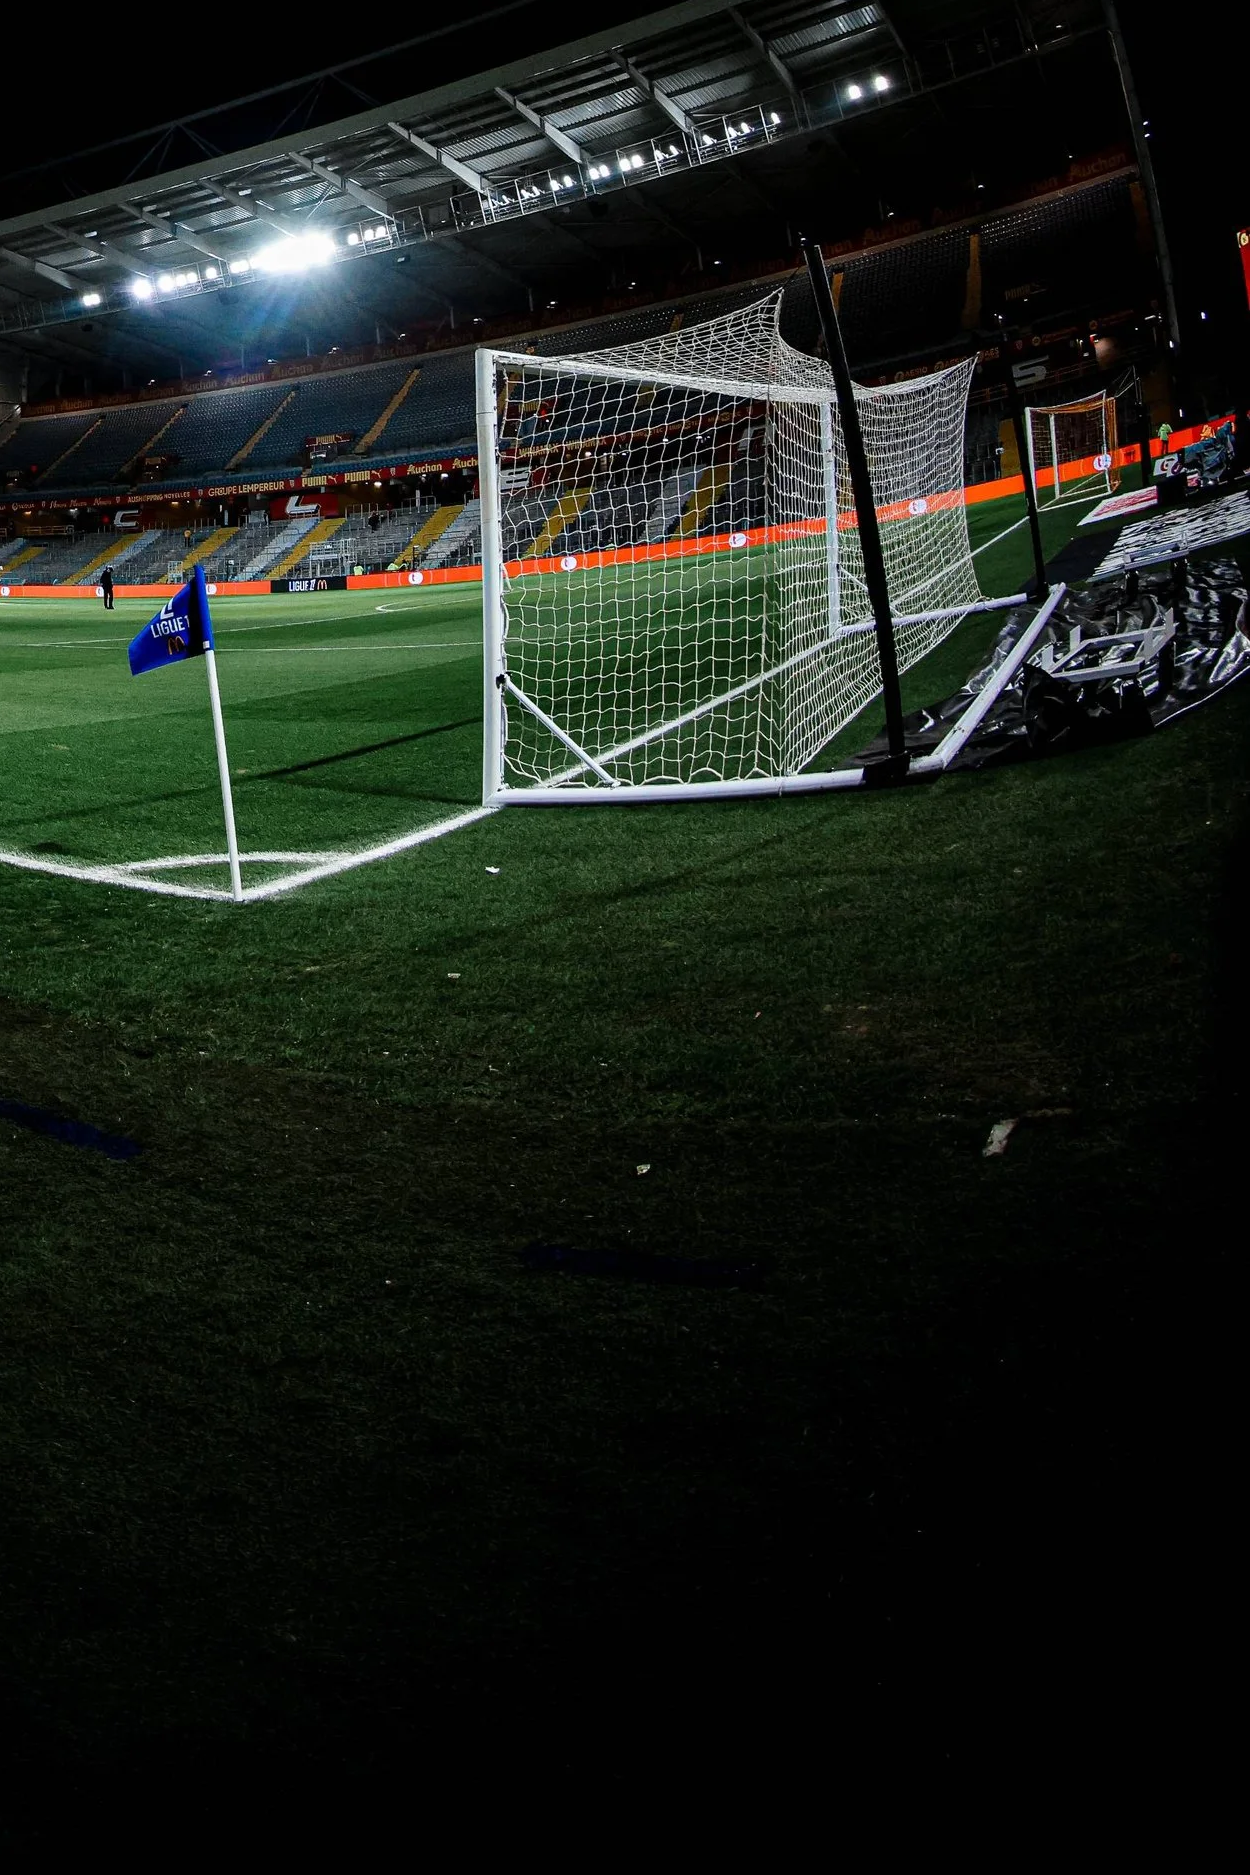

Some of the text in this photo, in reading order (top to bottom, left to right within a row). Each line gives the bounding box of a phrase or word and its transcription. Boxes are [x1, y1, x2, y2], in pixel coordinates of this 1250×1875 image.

[1067, 151, 1127, 181] Auchan
[406, 457, 478, 475] Auchan Auch
[302, 470, 371, 487] PUMA PUMA
[208, 480, 285, 497] GROUPE LEMPEREUR
[288, 580, 309, 592] LIGUE
[151, 616, 186, 639] LIGUE
